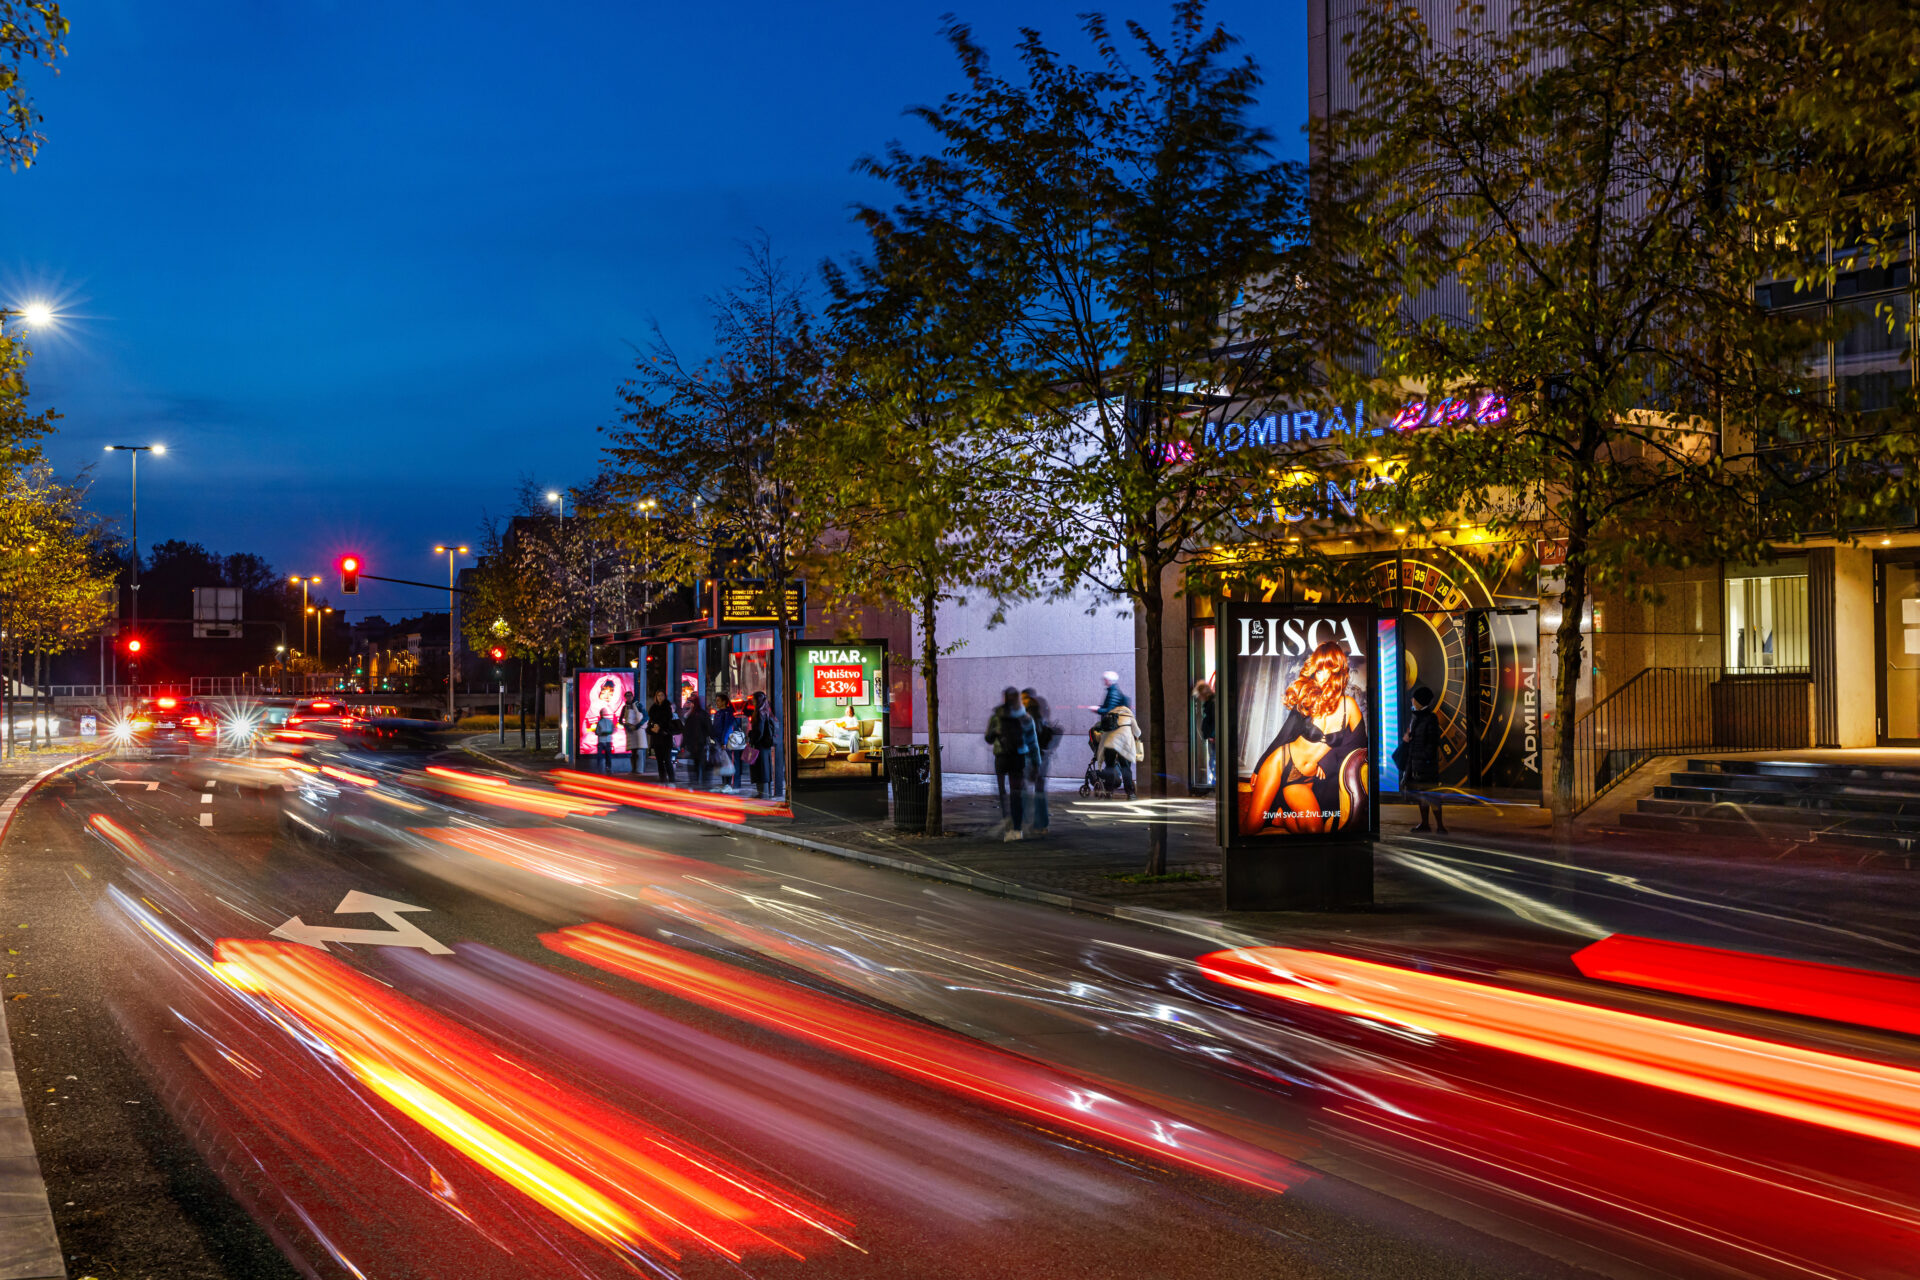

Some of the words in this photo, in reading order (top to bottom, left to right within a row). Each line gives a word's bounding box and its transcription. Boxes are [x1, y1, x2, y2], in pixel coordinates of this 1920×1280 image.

[1204, 399, 1385, 458] ADMIRAL
[1403, 568, 1412, 580] 12
[1414, 568, 1426, 583] 35
[1428, 575, 1436, 587] 3
[1260, 577, 1279, 603] 7
[1436, 581, 1449, 597] 26
[1448, 593, 1457, 605] 0
[1238, 617, 1365, 657] LISCA
[808, 649, 868, 664] RUTAR.
[816, 669, 861, 679] Pohištvo
[1522, 657, 1539, 774] ADMIRAL
[1263, 810, 1282, 819] ŽIVIM
[1283, 810, 1305, 818] SVOJE
[1305, 809, 1342, 818] ŽIVLJENJE
